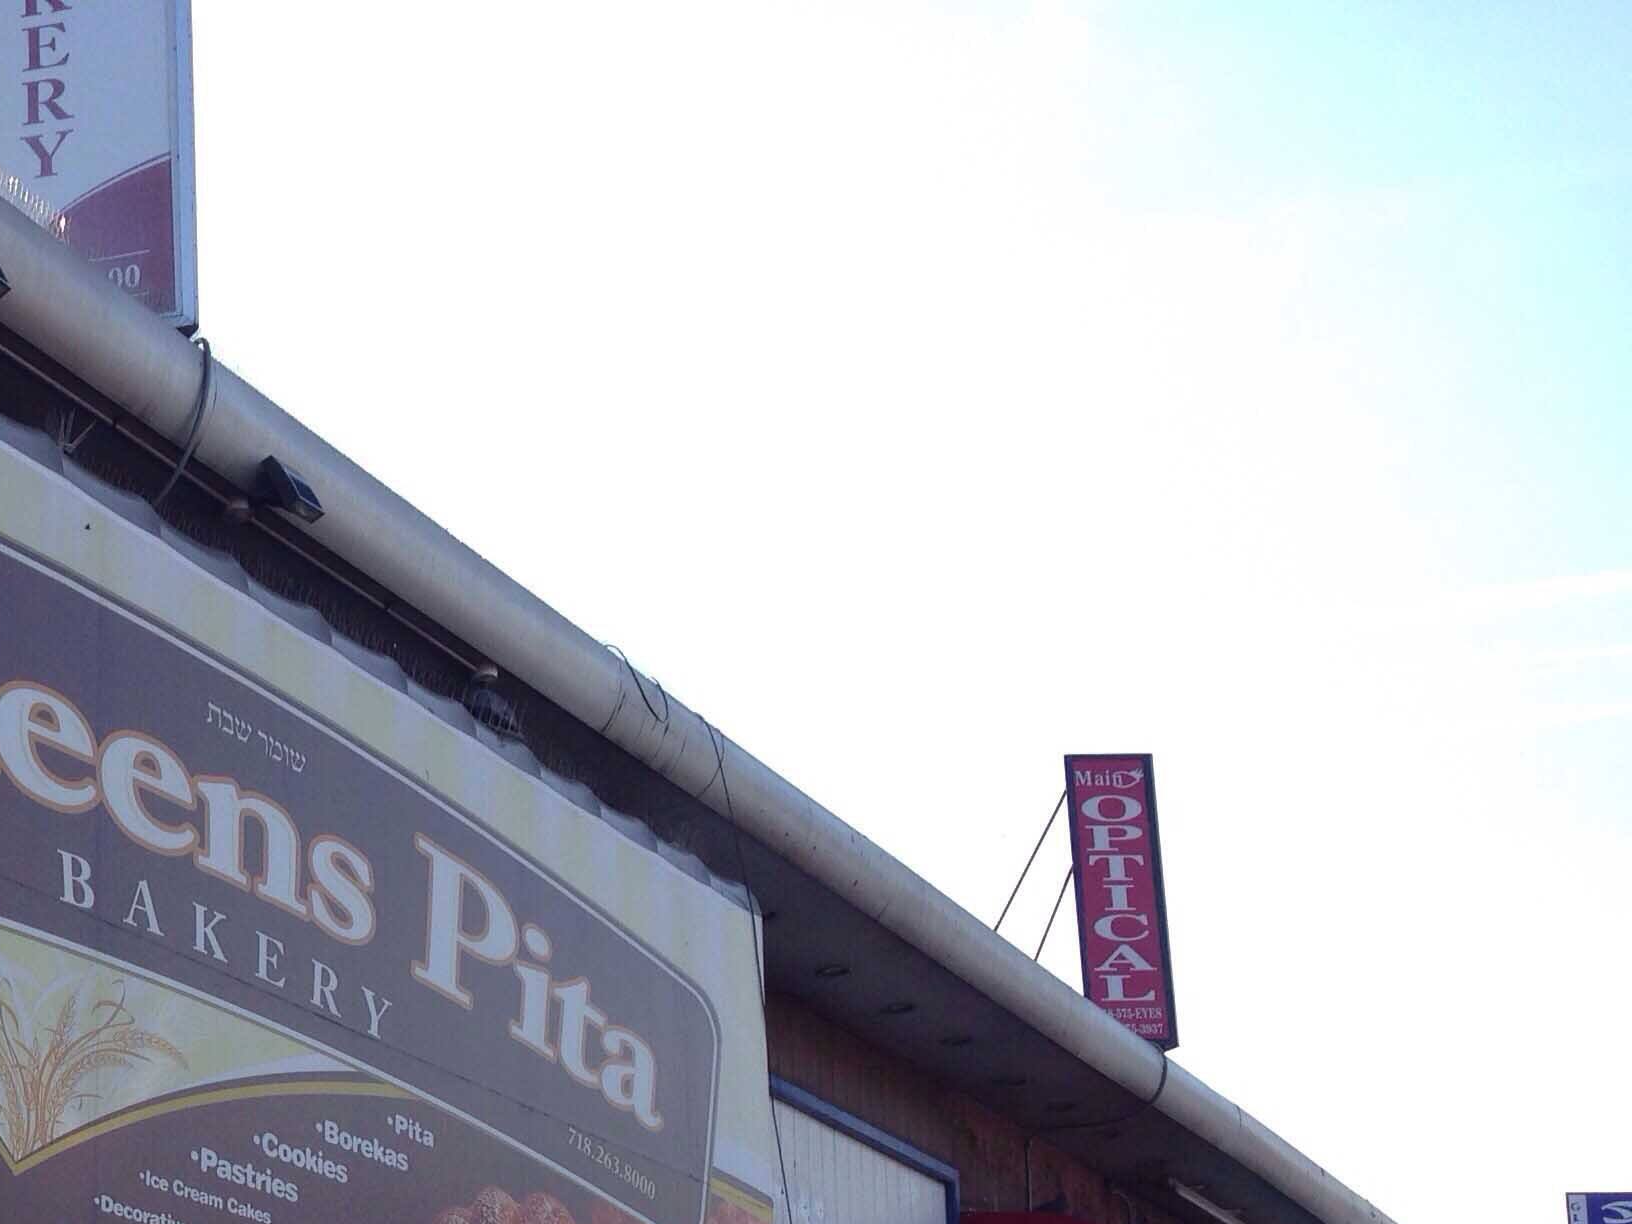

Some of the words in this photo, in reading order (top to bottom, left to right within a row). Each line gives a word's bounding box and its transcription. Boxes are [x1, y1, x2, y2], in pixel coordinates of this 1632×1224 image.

[1074, 770, 1124, 787] Main
[57, 849, 393, 1041] BAKERY
[1081, 795, 1157, 1002] OPTICAL
[411, 832, 664, 1131] Pita
[172, 1179, 224, 1211] Cream
[227, 1197, 272, 1224] Cakes
[568, 1127, 656, 1200] 718.263.8000
